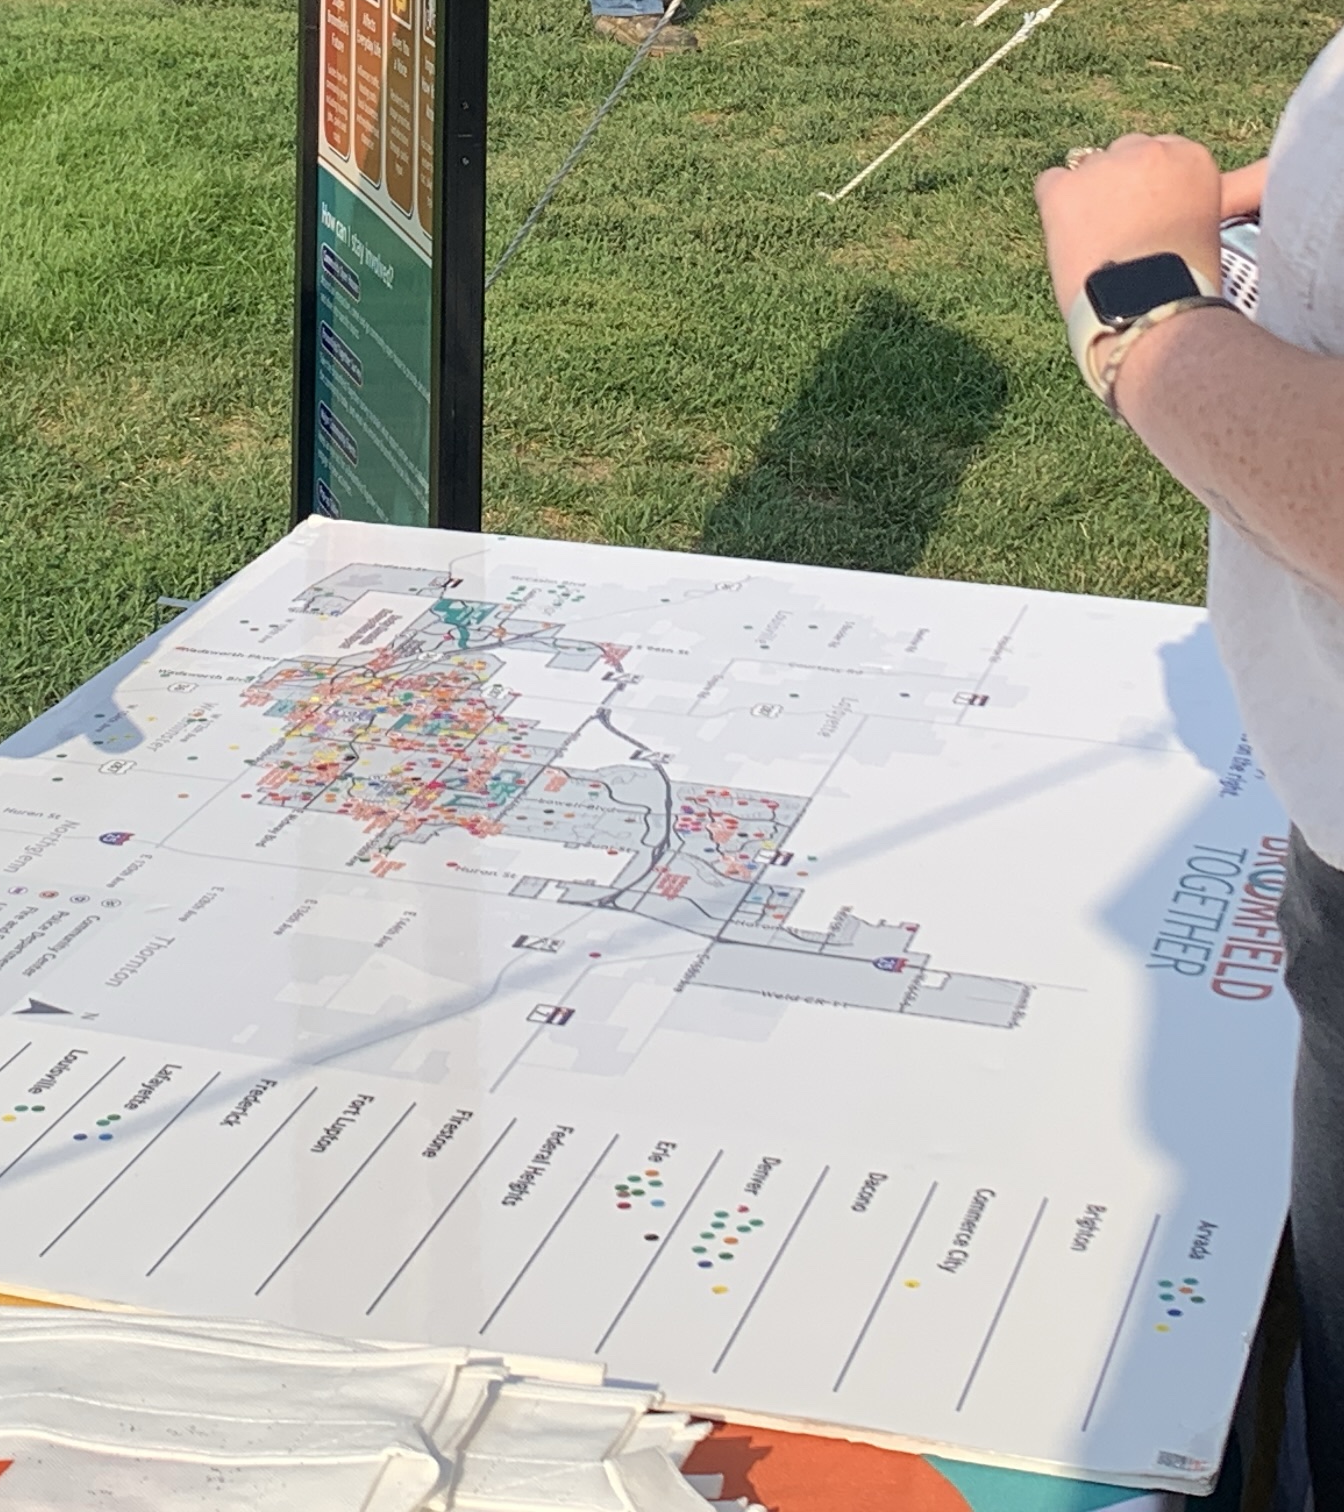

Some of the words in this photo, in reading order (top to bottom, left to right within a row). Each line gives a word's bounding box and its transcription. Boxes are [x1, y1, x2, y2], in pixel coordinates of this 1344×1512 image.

[321, 201, 336, 231] How
[336, 219, 347, 245] can
[351, 233, 364, 265] stay
[365, 242, 394, 290] involved?
[755, 609, 794, 644] Louisville
[817, 697, 859, 738] Lafayette
[1229, 755, 1253, 772] the
[1237, 743, 1253, 758] on
[4, 820, 78, 872] Northglenn
[255, 834, 276, 847] Blvd
[105, 876, 124, 888] Ave
[14, 906, 38, 920] Fire
[38, 910, 69, 930] Police
[178, 909, 196, 922] Ave
[273, 923, 291, 935] Ave
[1145, 844, 1249, 978] TOGETHER
[47, 915, 99, 952] Community
[373, 935, 391, 948] Ave
[22, 953, 56, 976] Center
[105, 936, 174, 986] Thornton
[28, 1049, 86, 1093] Louisville
[124, 1064, 180, 1109] Lafayette
[220, 1078, 276, 1125] Frederick
[342, 1094, 374, 1115] Fort
[311, 1117, 354, 1152] Lupton
[422, 1110, 472, 1157] Firestone
[532, 1125, 573, 1164] Federal
[647, 1141, 676, 1162] Erie
[501, 1166, 543, 1205] Heights
[745, 1157, 780, 1194] Denver
[851, 1172, 887, 1211] Dacono
[953, 1188, 994, 1246] Commerce
[1072, 1204, 1105, 1251] Brighton
[1189, 1220, 1216, 1259] Arvada
[937, 1249, 968, 1273] City
